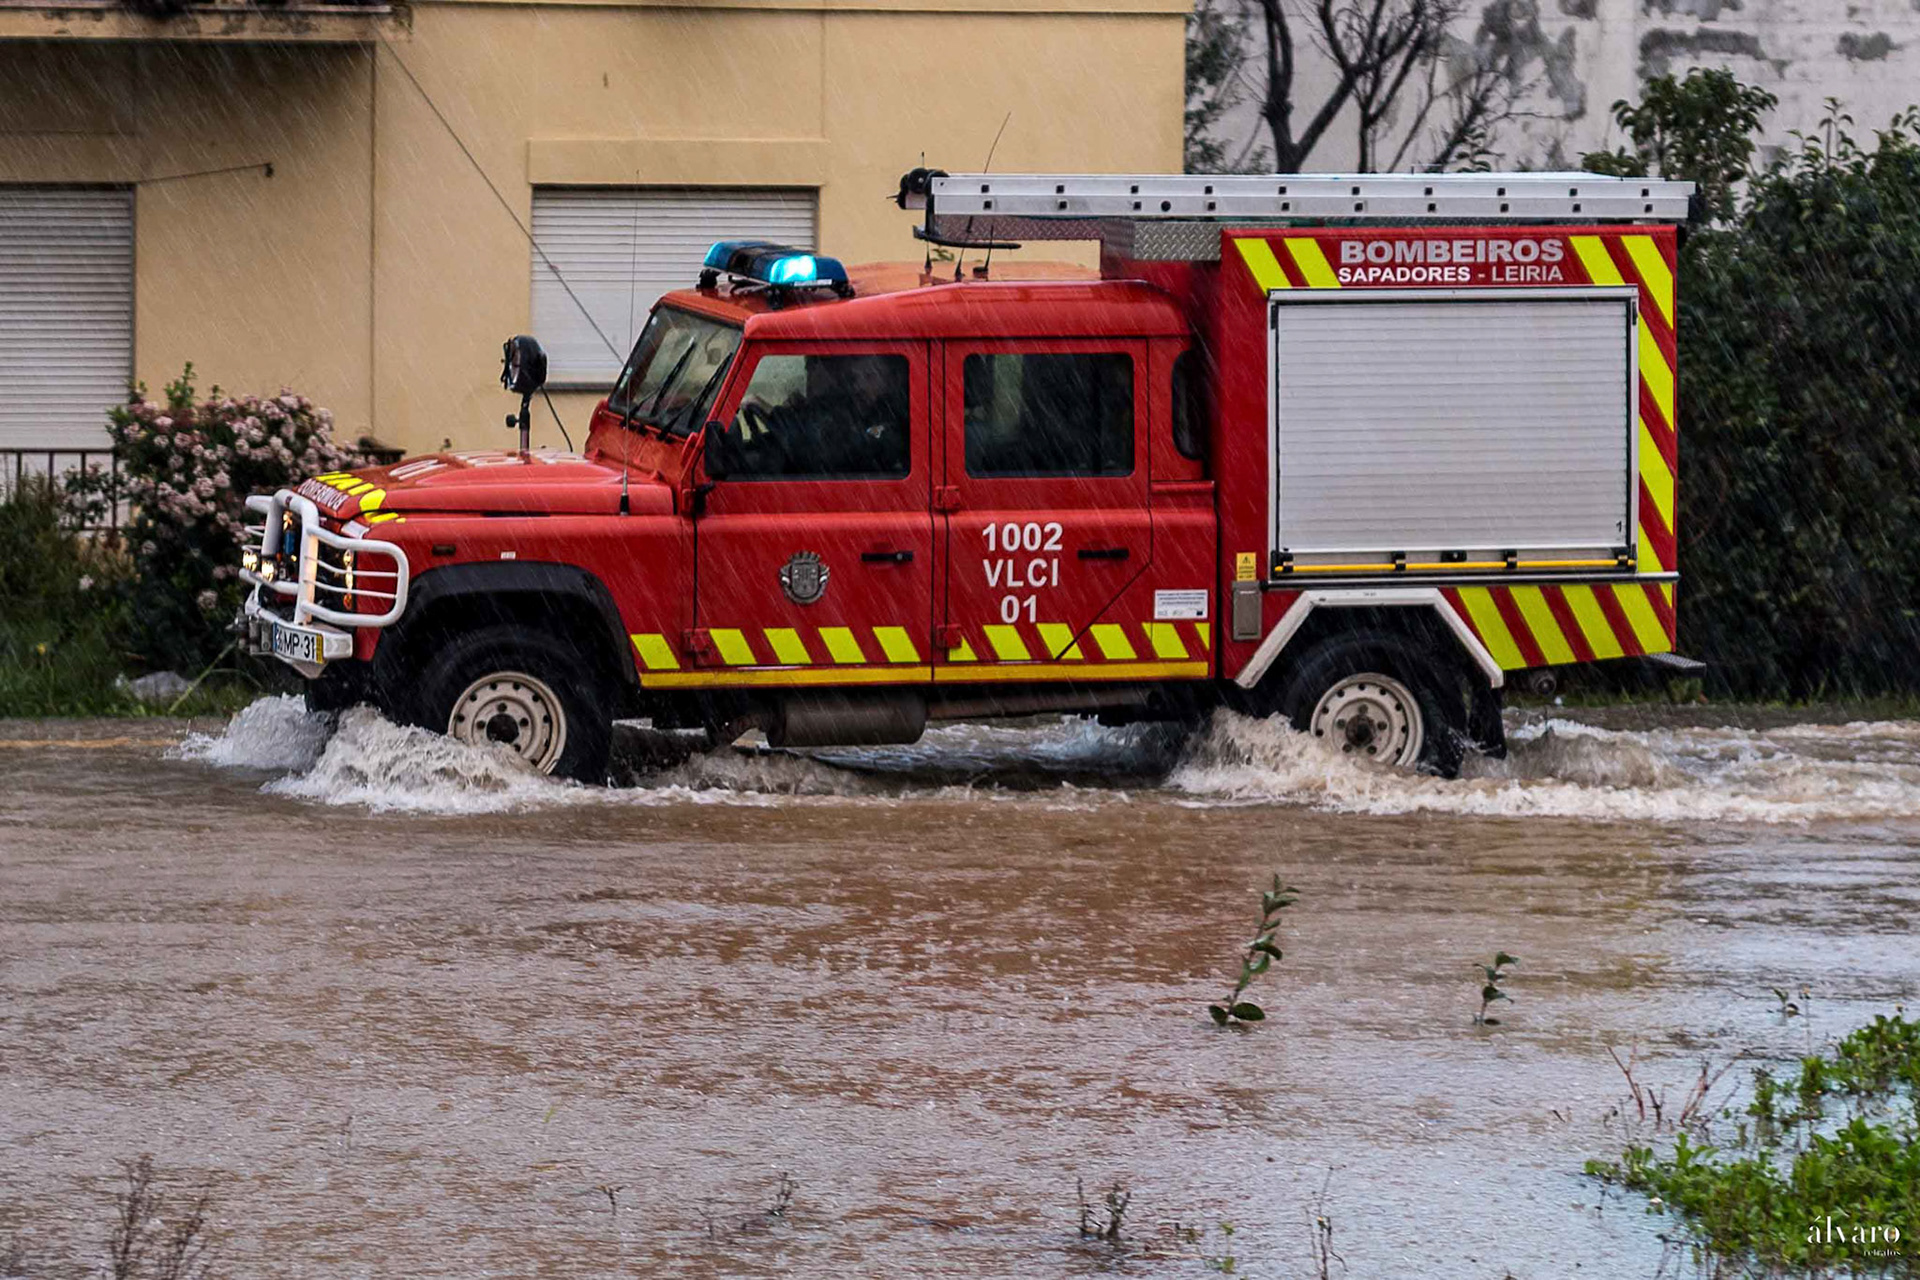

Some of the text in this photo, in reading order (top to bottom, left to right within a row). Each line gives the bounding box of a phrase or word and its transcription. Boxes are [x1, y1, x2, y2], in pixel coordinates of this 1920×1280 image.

[1340, 239, 1564, 264] BOMBEIROS
[1338, 266, 1471, 282] SAPADORES
[1491, 265, 1564, 282] LEIRIA
[982, 522, 1064, 552] 1002
[982, 558, 1059, 588] VLCI
[1000, 594, 1038, 624] 01
